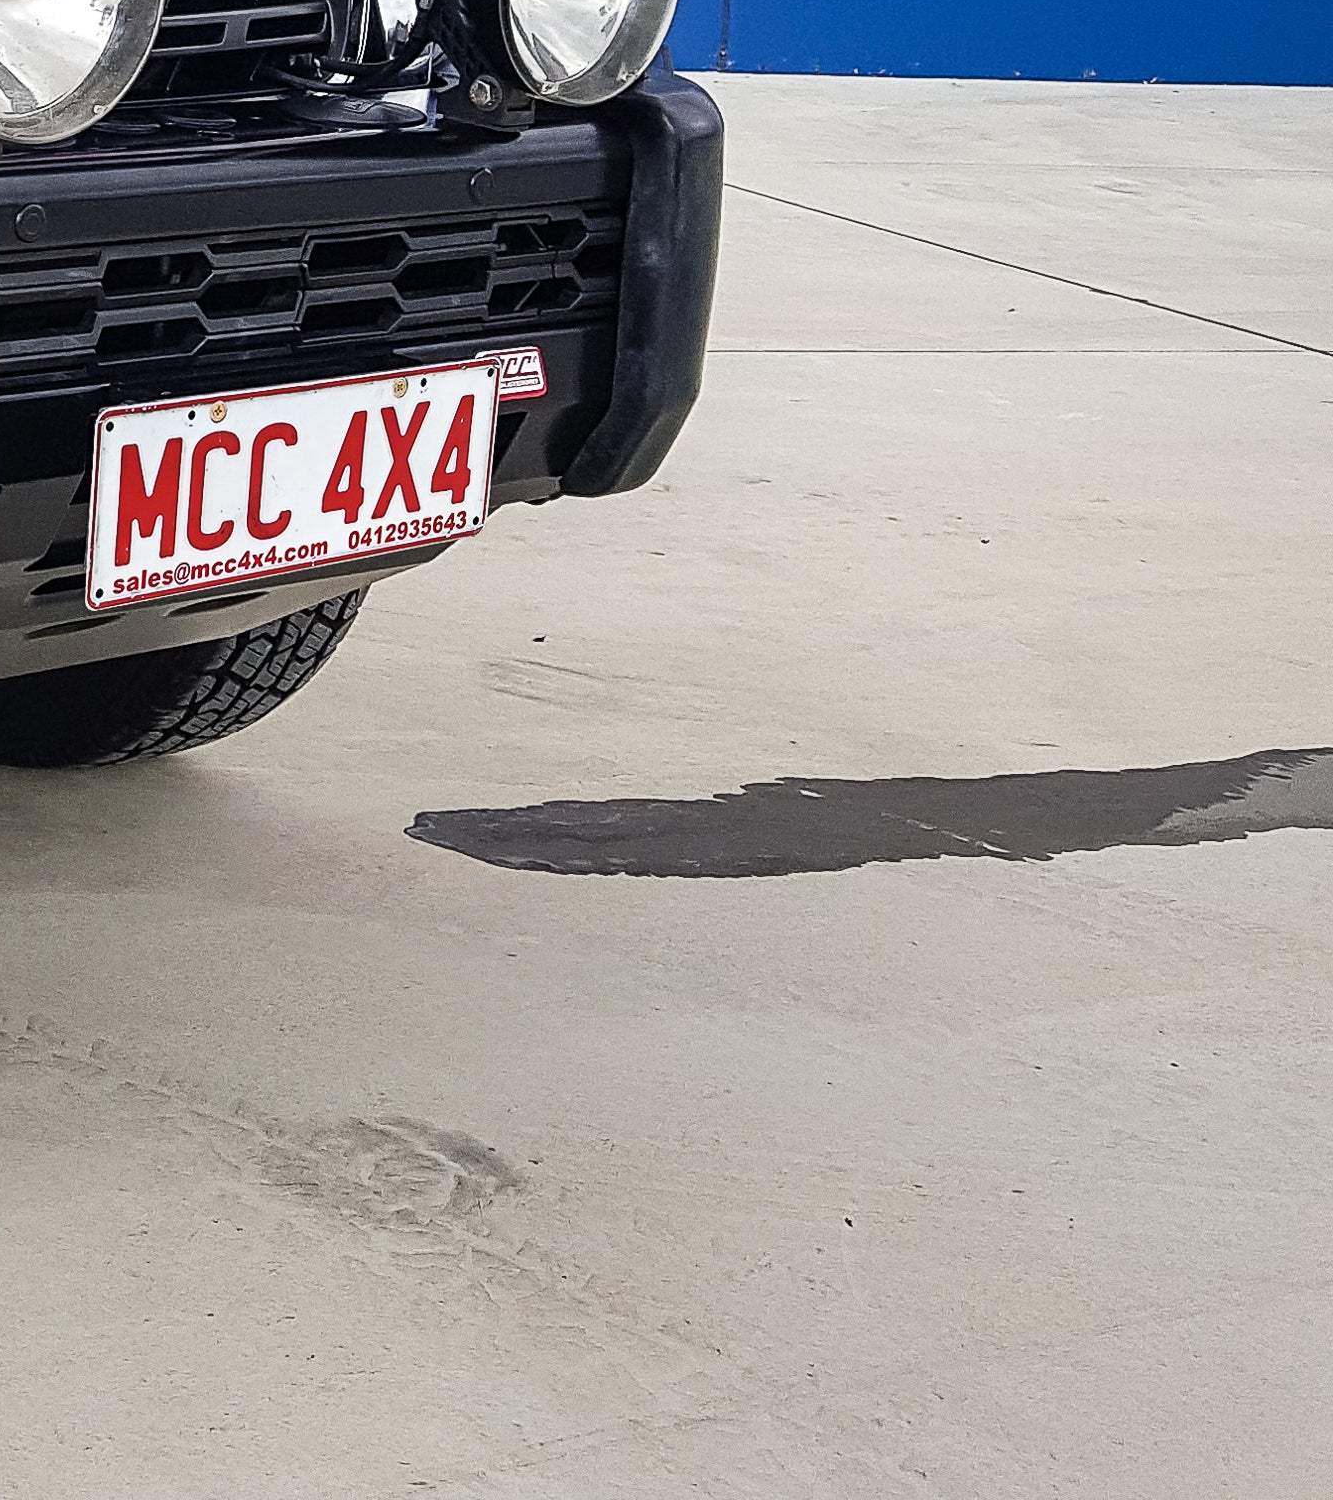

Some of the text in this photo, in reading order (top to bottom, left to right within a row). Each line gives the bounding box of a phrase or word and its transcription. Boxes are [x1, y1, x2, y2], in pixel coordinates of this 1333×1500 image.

[114, 394, 475, 567] MCC 4X4
[112, 511, 468, 595] sales@mcc4x4.com 0412935643
